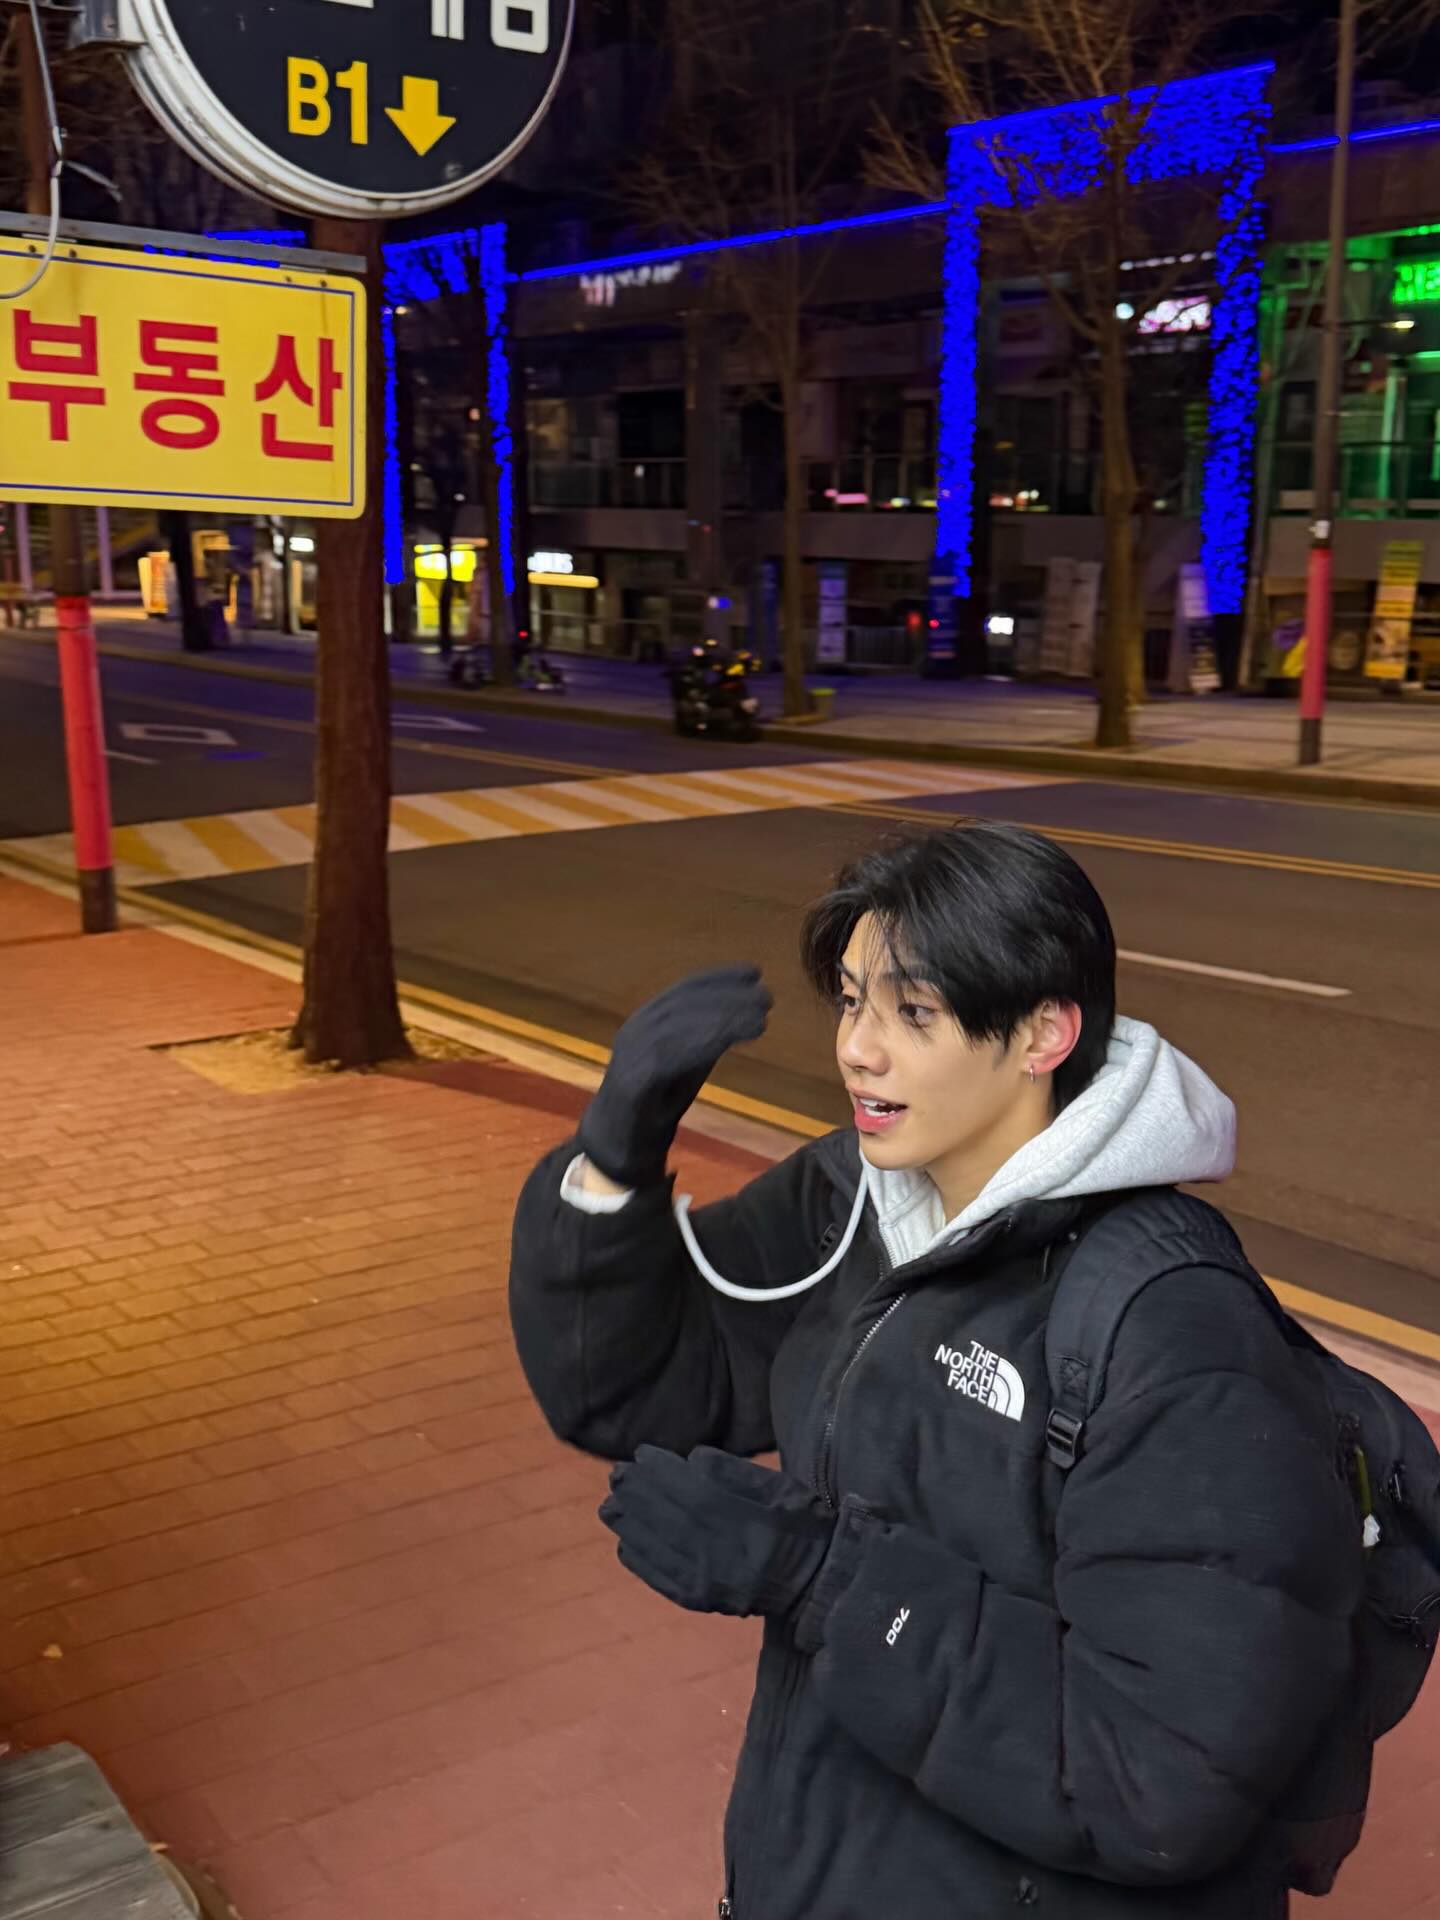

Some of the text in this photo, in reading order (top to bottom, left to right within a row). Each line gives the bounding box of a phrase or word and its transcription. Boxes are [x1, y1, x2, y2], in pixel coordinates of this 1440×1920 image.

[287, 56, 368, 145] B1
[8, 308, 343, 462] 부동산
[934, 1343, 996, 1389] NORTH
[969, 1340, 999, 1371] THE
[947, 1370, 989, 1405] FACE
[885, 1607, 911, 1646] 700
